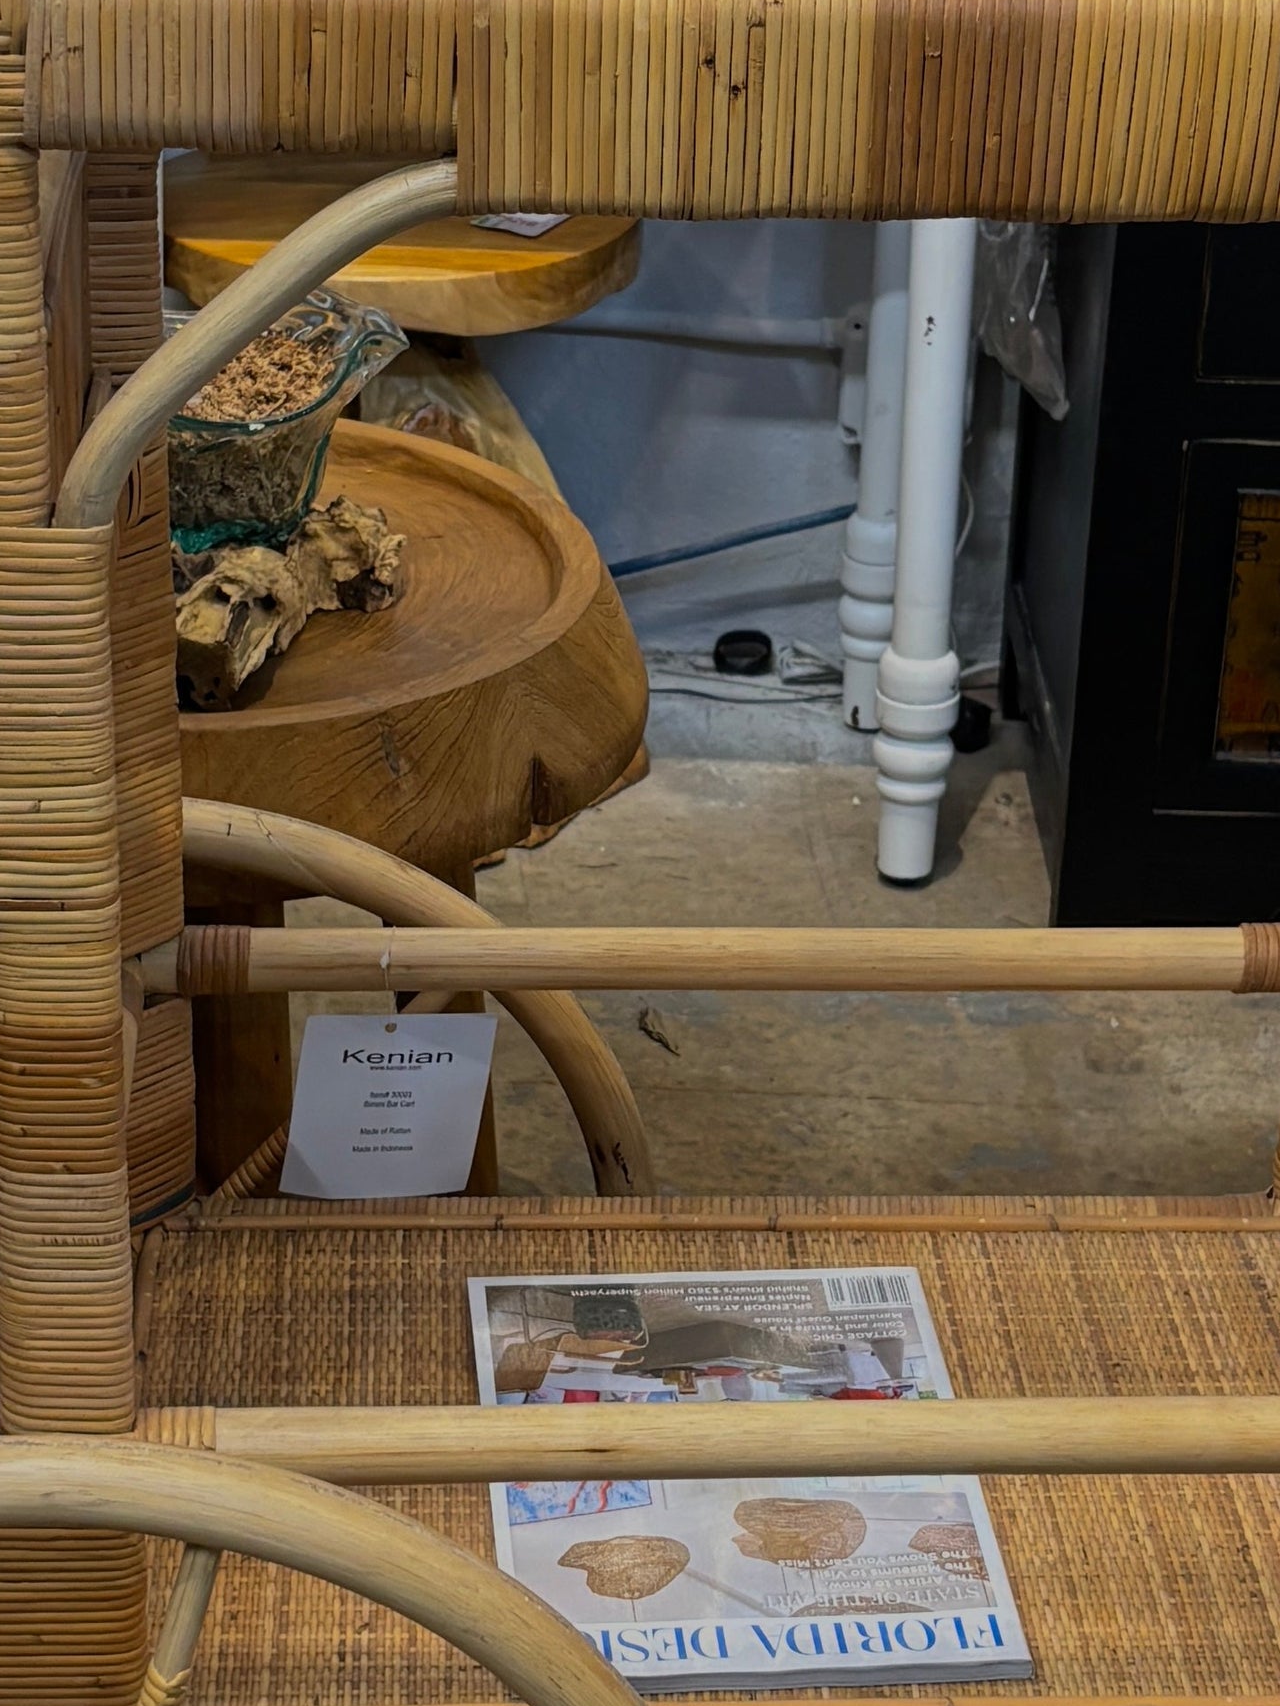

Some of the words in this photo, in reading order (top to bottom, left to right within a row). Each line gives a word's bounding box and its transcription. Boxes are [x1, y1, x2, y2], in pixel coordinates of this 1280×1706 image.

[342, 1049, 454, 1064] Kenian
[360, 1127, 379, 1135] Made
[352, 1145, 371, 1153] Made
[571, 1288, 641, 1298] Superyacht
[643, 1287, 685, 1296] Million
[685, 1294, 766, 1302] Entrepreneur
[695, 1304, 720, 1312] SEA
[722, 1304, 740, 1312] AT
[744, 1303, 813, 1311] SPLENDOR
[754, 1316, 794, 1324] House
[796, 1315, 832, 1323] Guest
[835, 1313, 903, 1322] Manalapan
[796, 1323, 842, 1331] Texture
[845, 1322, 870, 1330] and
[873, 1320, 905, 1328] Color
[848, 1329, 908, 1340] COTTAGE
[888, 1551, 939, 1564] Shows
[942, 1549, 972, 1559] The
[777, 1558, 811, 1569] Miss
[815, 1557, 854, 1569] Can't
[858, 1555, 888, 1566] You
[872, 1564, 941, 1577] Museums
[945, 1561, 974, 1571] The
[851, 1568, 868, 1578] to
[948, 1572, 975, 1582] The
[875, 1579, 892, 1589] to
[895, 1574, 944, 1589] Artists
[766, 1591, 811, 1610] ART
[817, 1591, 868, 1608] THE
[869, 1592, 901, 1606] OF
[909, 1586, 981, 1605] STATE
[751, 1614, 1005, 1659] FLORIDA
